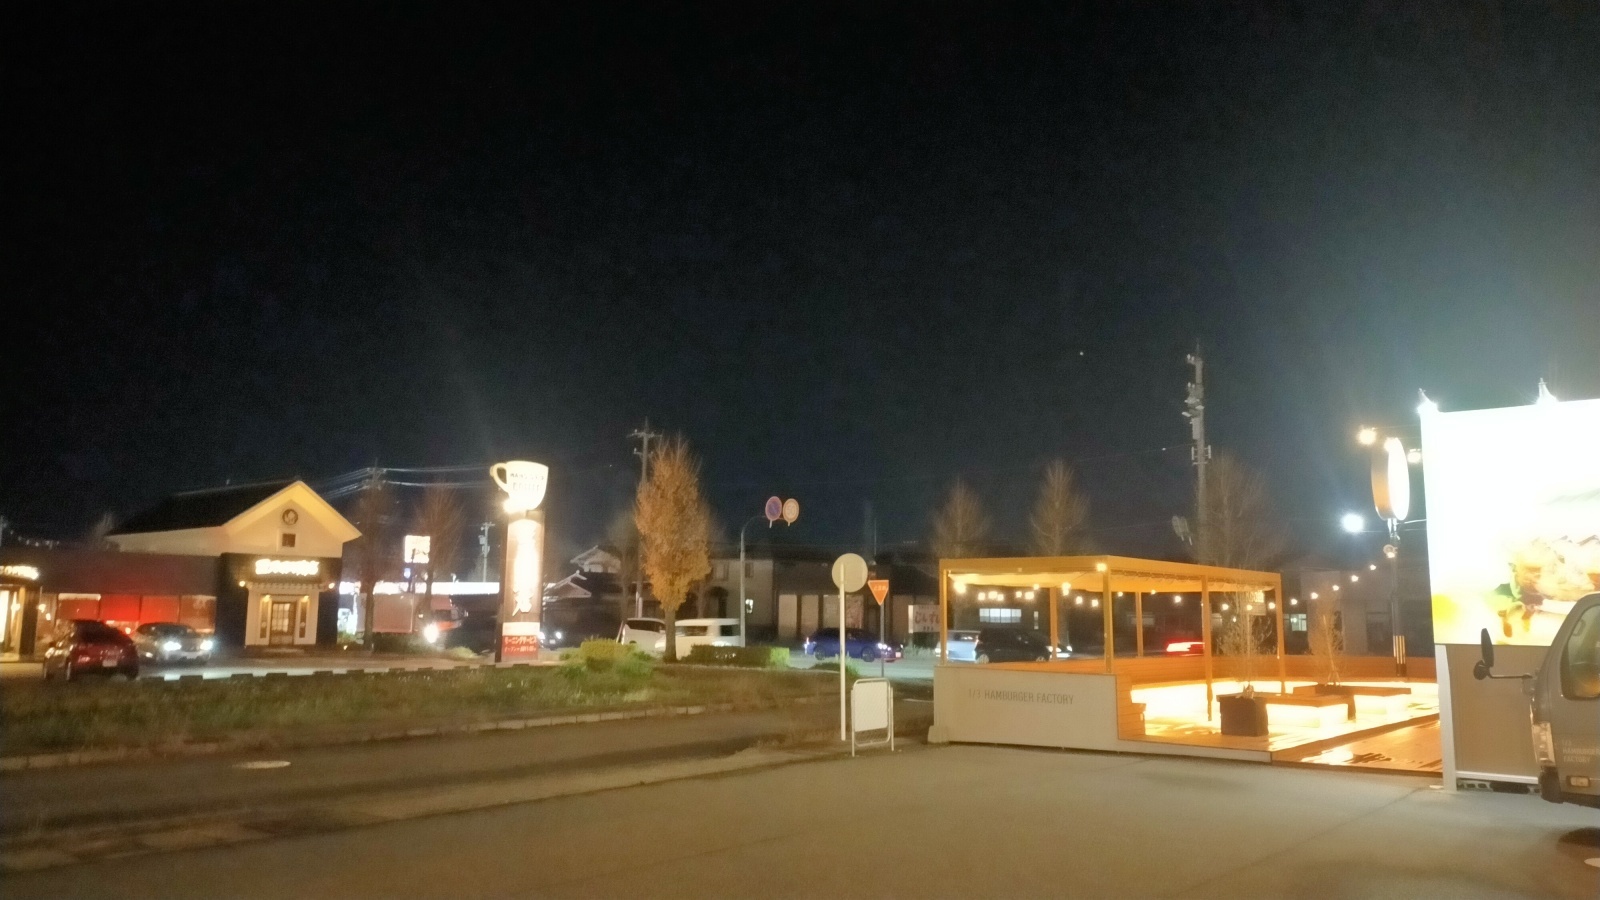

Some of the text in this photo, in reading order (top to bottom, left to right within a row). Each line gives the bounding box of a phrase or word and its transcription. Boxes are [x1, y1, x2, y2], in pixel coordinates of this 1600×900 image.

[968, 688, 1074, 705] 1/3 HAMBURGER FACTORY
